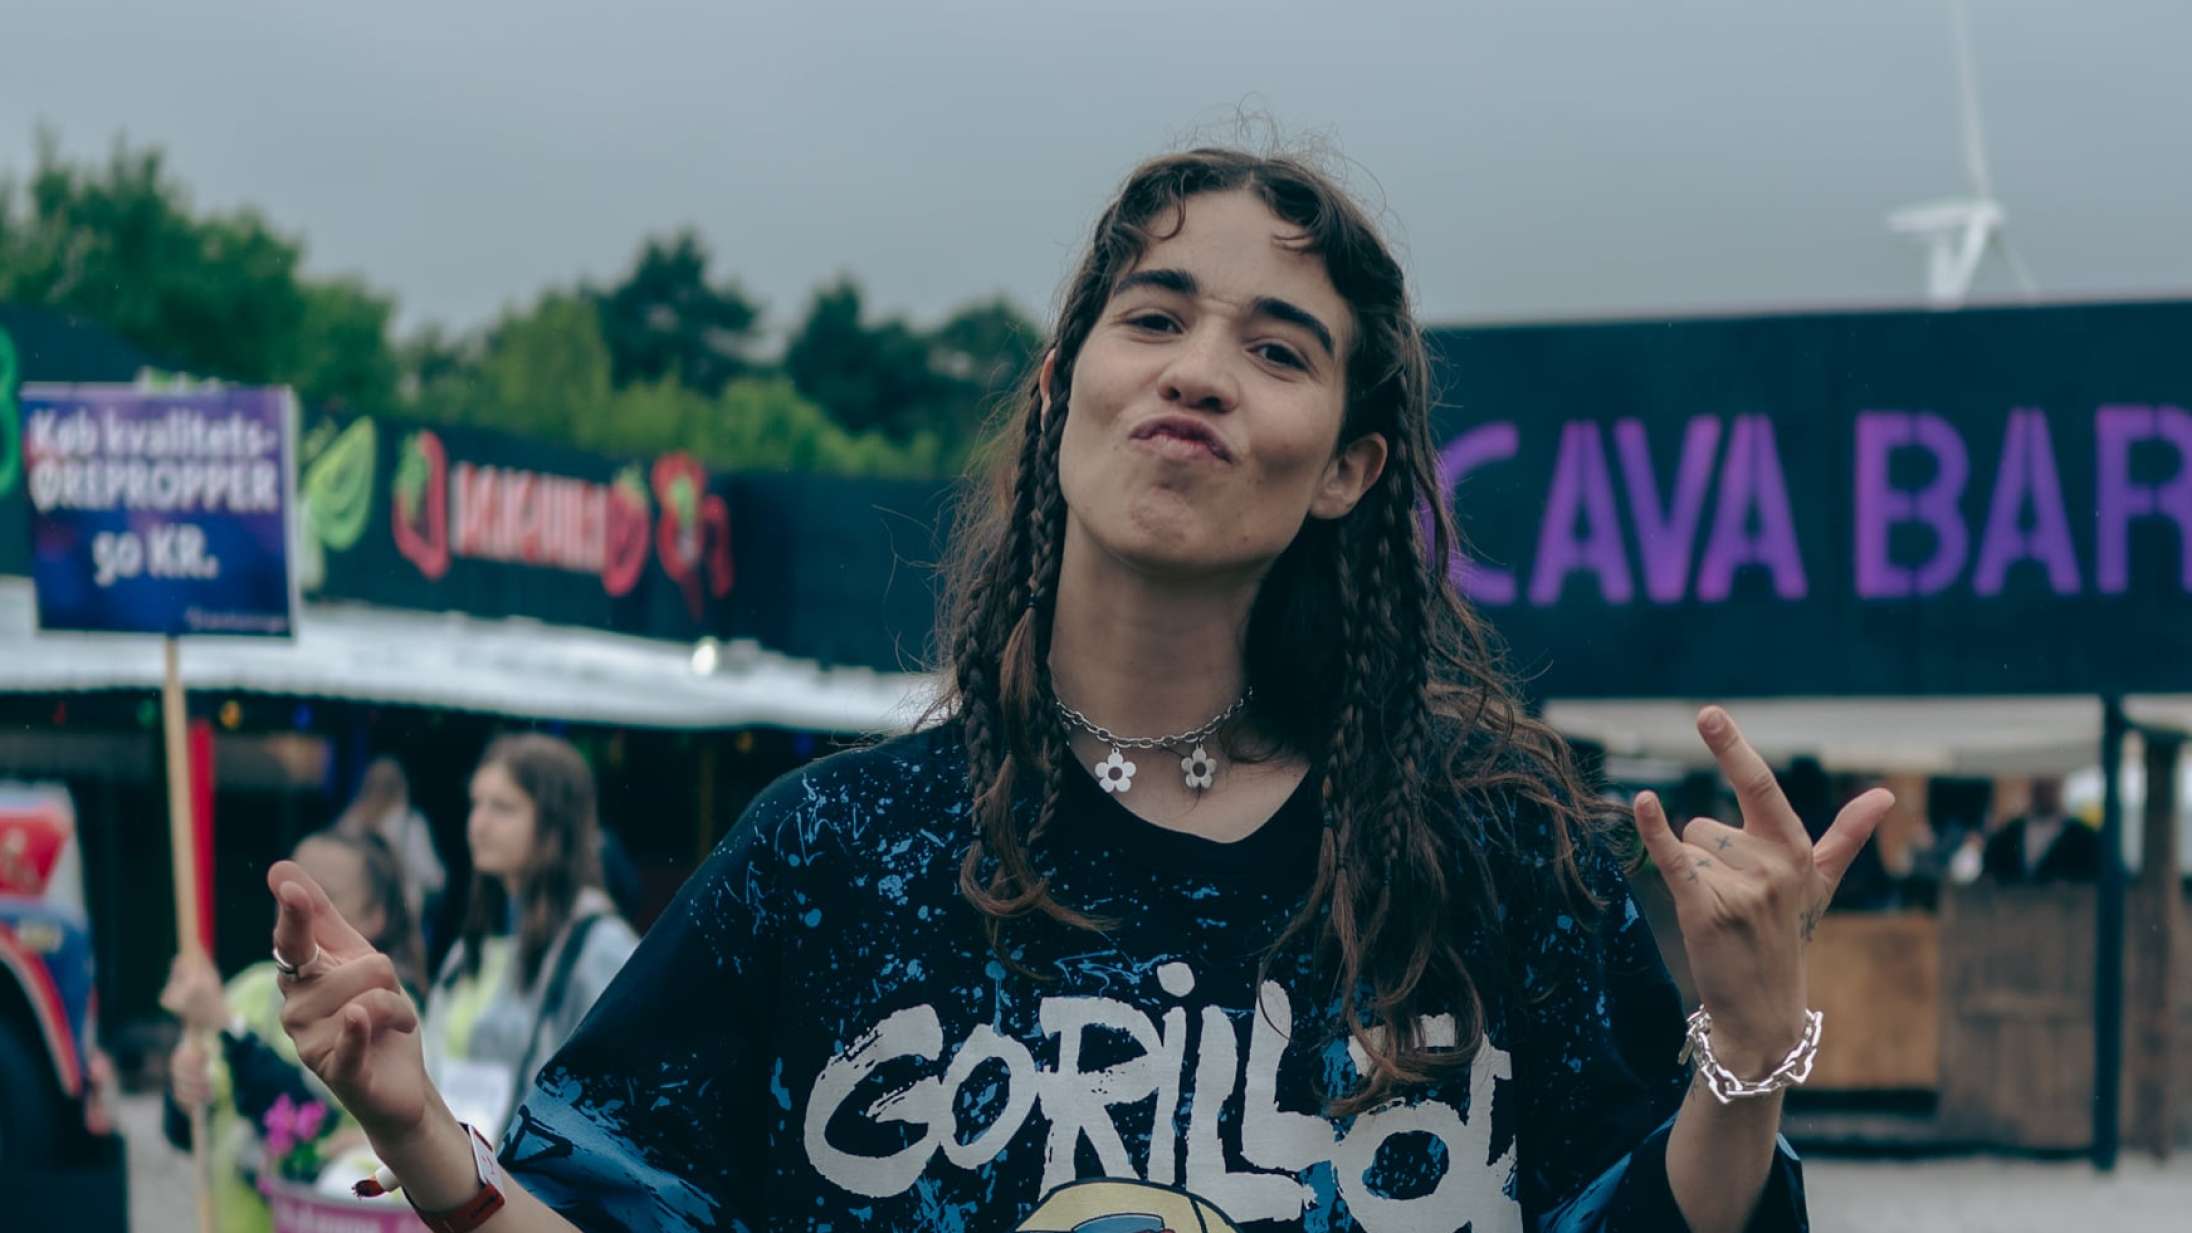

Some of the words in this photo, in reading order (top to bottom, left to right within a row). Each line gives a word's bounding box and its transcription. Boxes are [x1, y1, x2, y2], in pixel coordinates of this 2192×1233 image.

[28, 458, 281, 512] ØREPROPPER
[1416, 412, 1808, 605] CAVA
[1852, 406, 2192, 600] BAR
